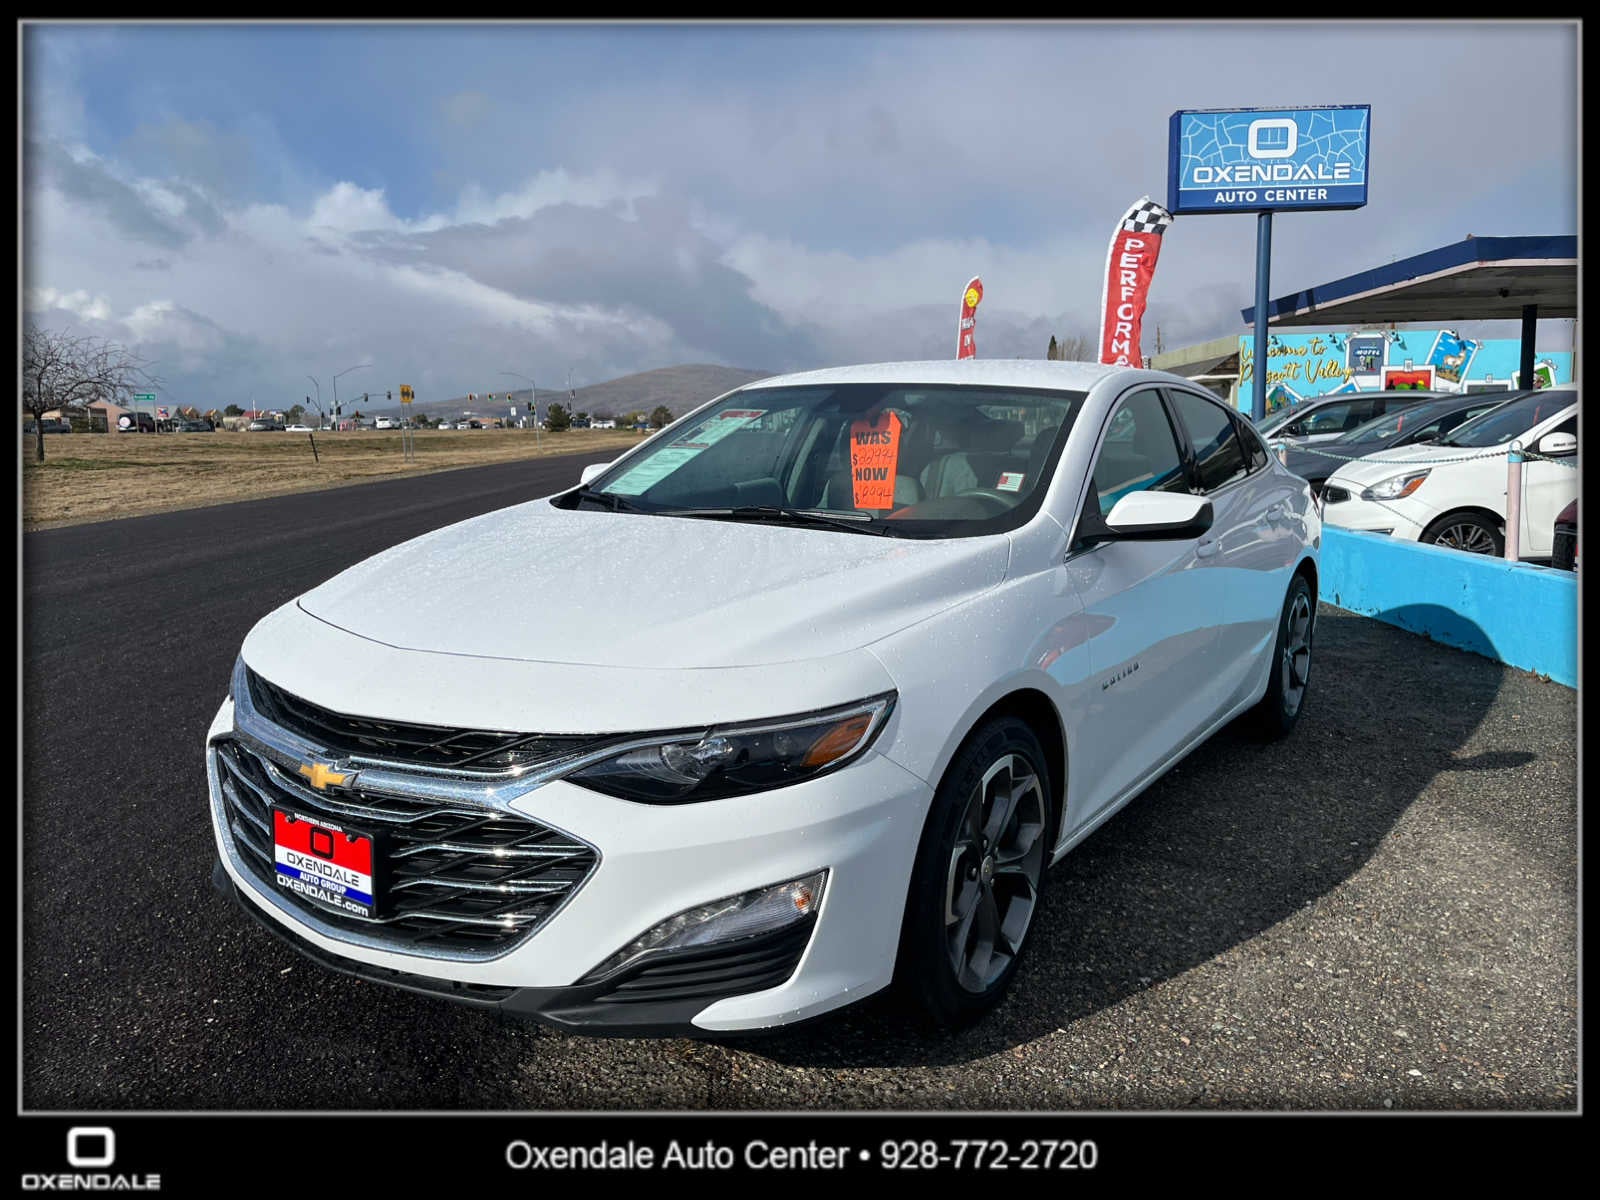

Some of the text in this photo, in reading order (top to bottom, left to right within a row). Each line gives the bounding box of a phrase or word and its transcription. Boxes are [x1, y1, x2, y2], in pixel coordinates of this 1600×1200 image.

[1193, 162, 1350, 183] OXENDALE
[1215, 189, 1328, 203] AUTO CENTER
[1309, 337, 1327, 355] to
[855, 431, 892, 446] WAS
[855, 467, 888, 481] NOW
[287, 852, 360, 887] OXENDALE
[300, 871, 347, 895] AUTO GROUP
[277, 874, 369, 917] OXENDALE.com
